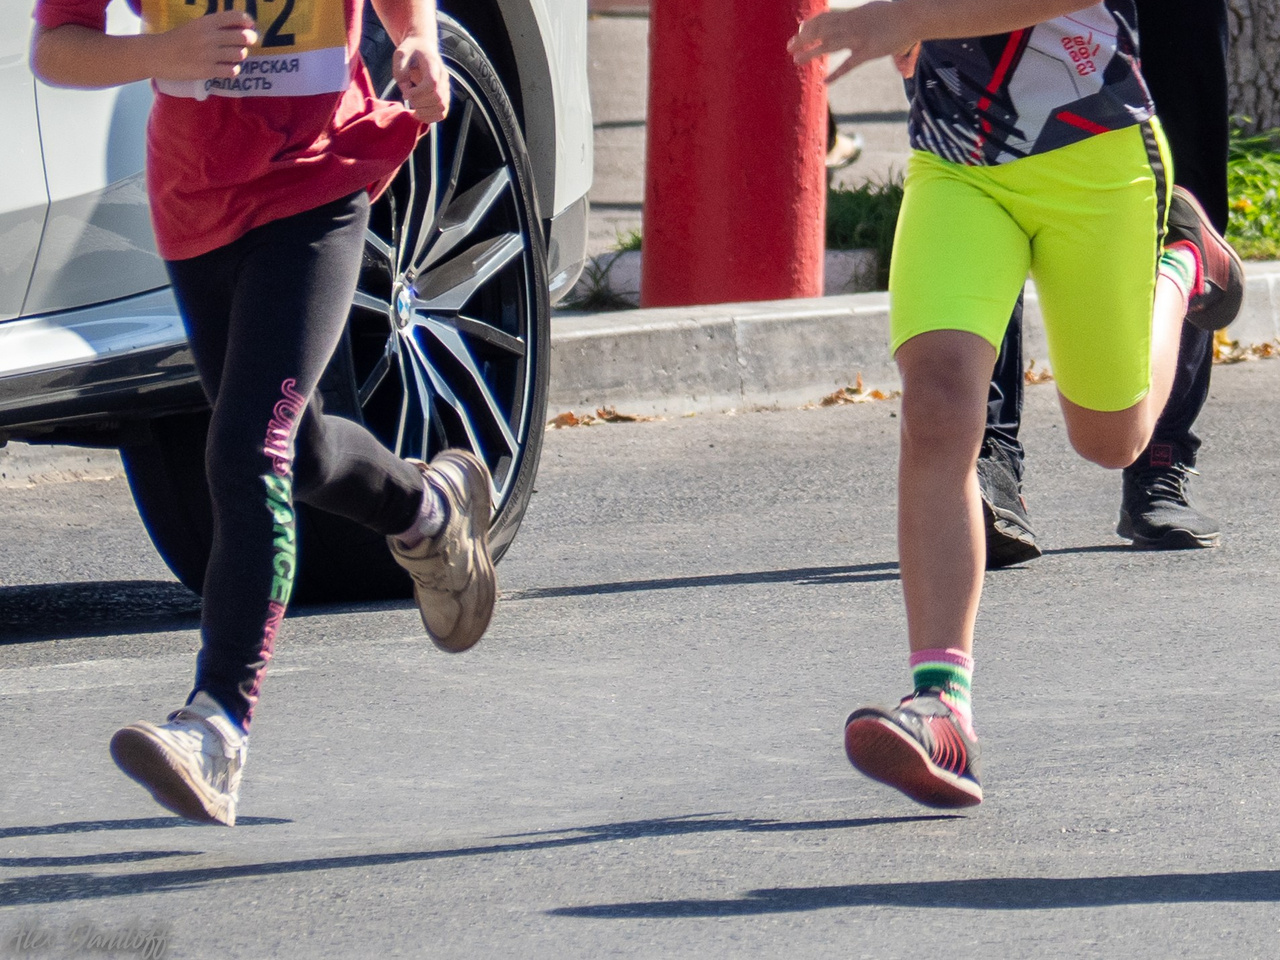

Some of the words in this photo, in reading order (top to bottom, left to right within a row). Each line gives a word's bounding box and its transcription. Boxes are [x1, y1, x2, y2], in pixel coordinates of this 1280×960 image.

[238, 58, 300, 74] ИРСКАЯ
[262, 378, 305, 477] JUMP
[259, 472, 297, 603] DANCE
